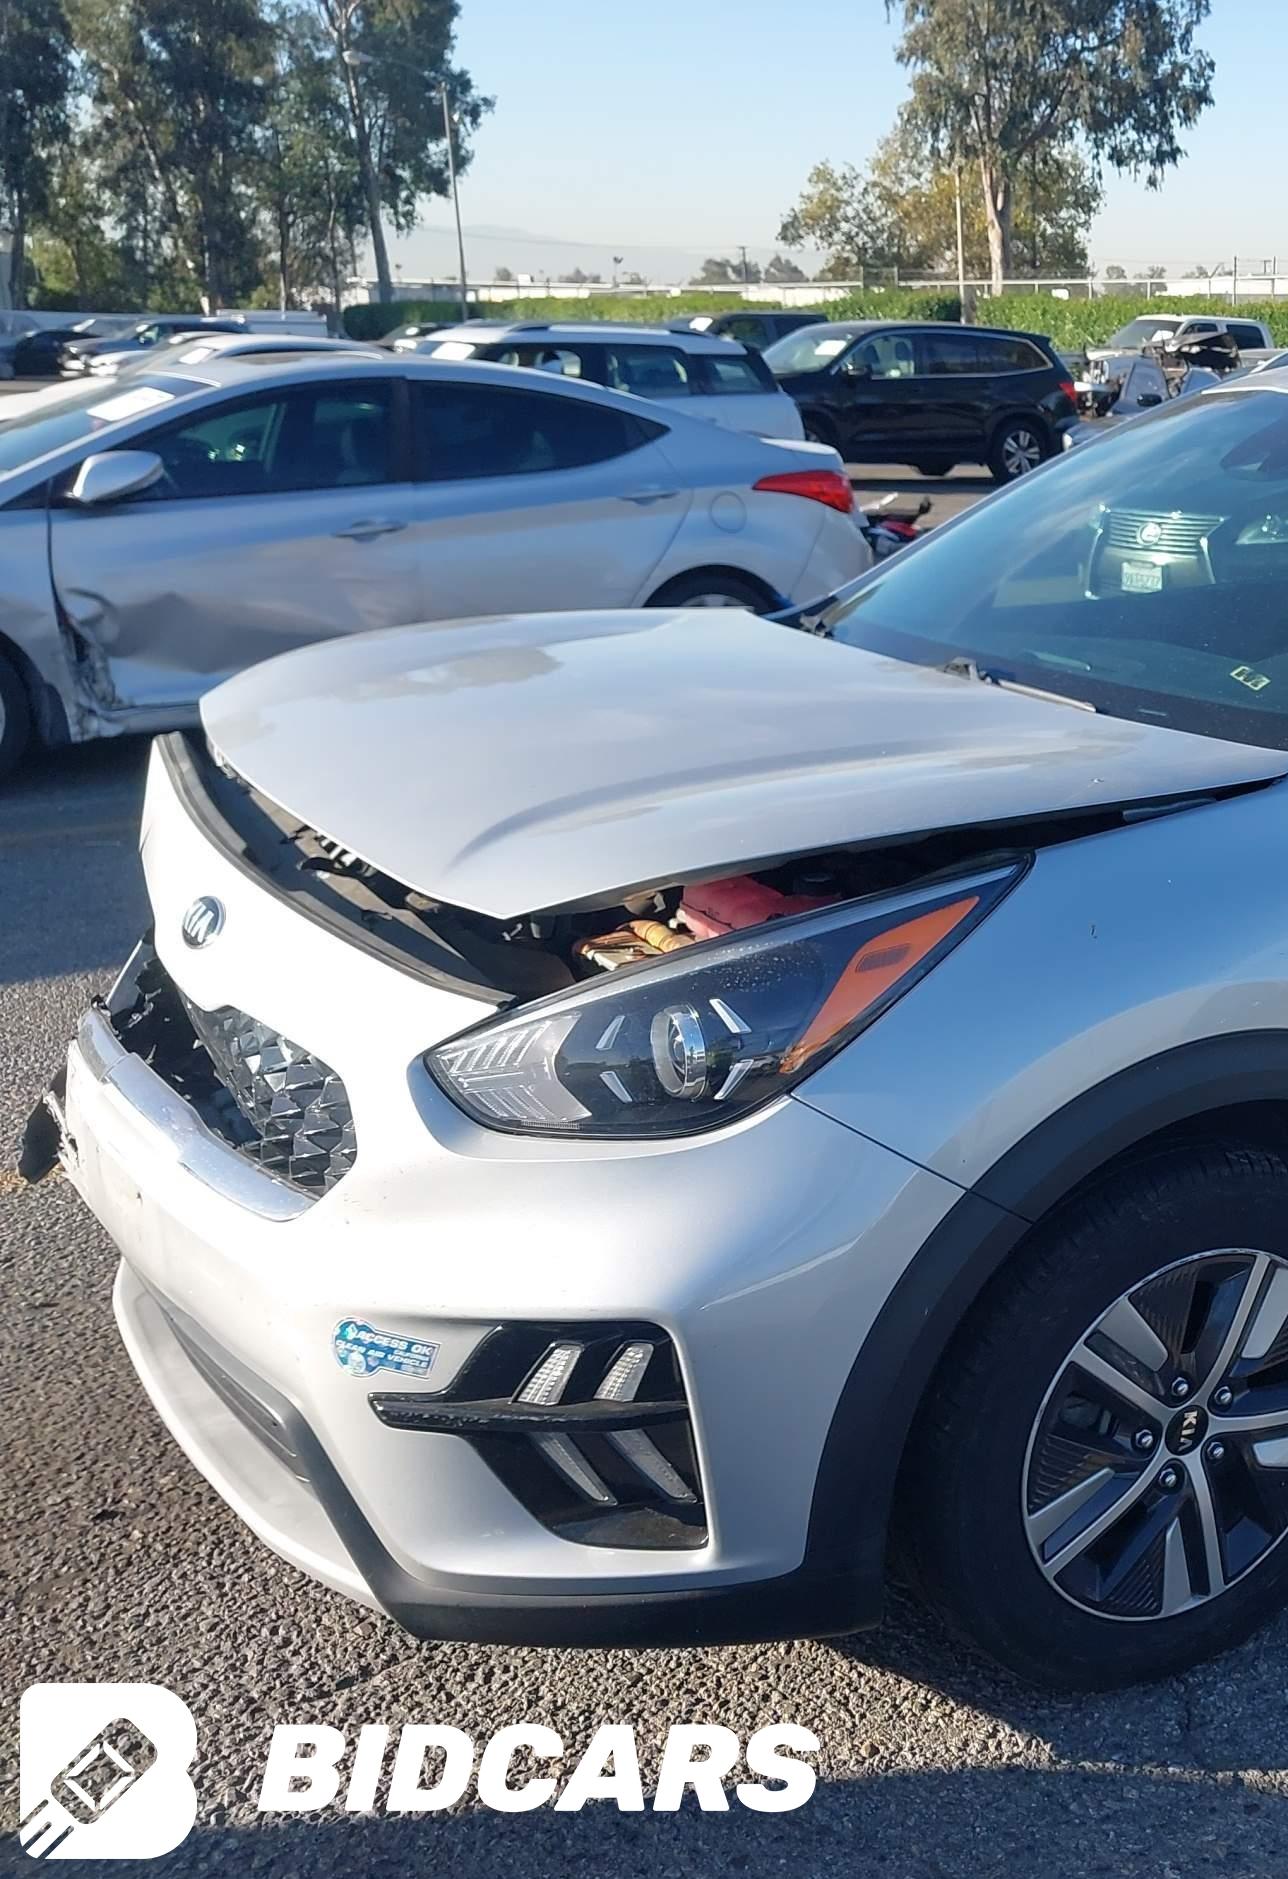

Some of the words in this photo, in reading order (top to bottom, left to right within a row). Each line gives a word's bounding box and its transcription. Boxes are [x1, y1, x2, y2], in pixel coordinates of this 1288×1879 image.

[357, 1331, 408, 1350] ACCESS
[411, 1344, 433, 1355] OK
[387, 1354, 428, 1368] VEHICLE
[1178, 1411, 1197, 1451] KIA
